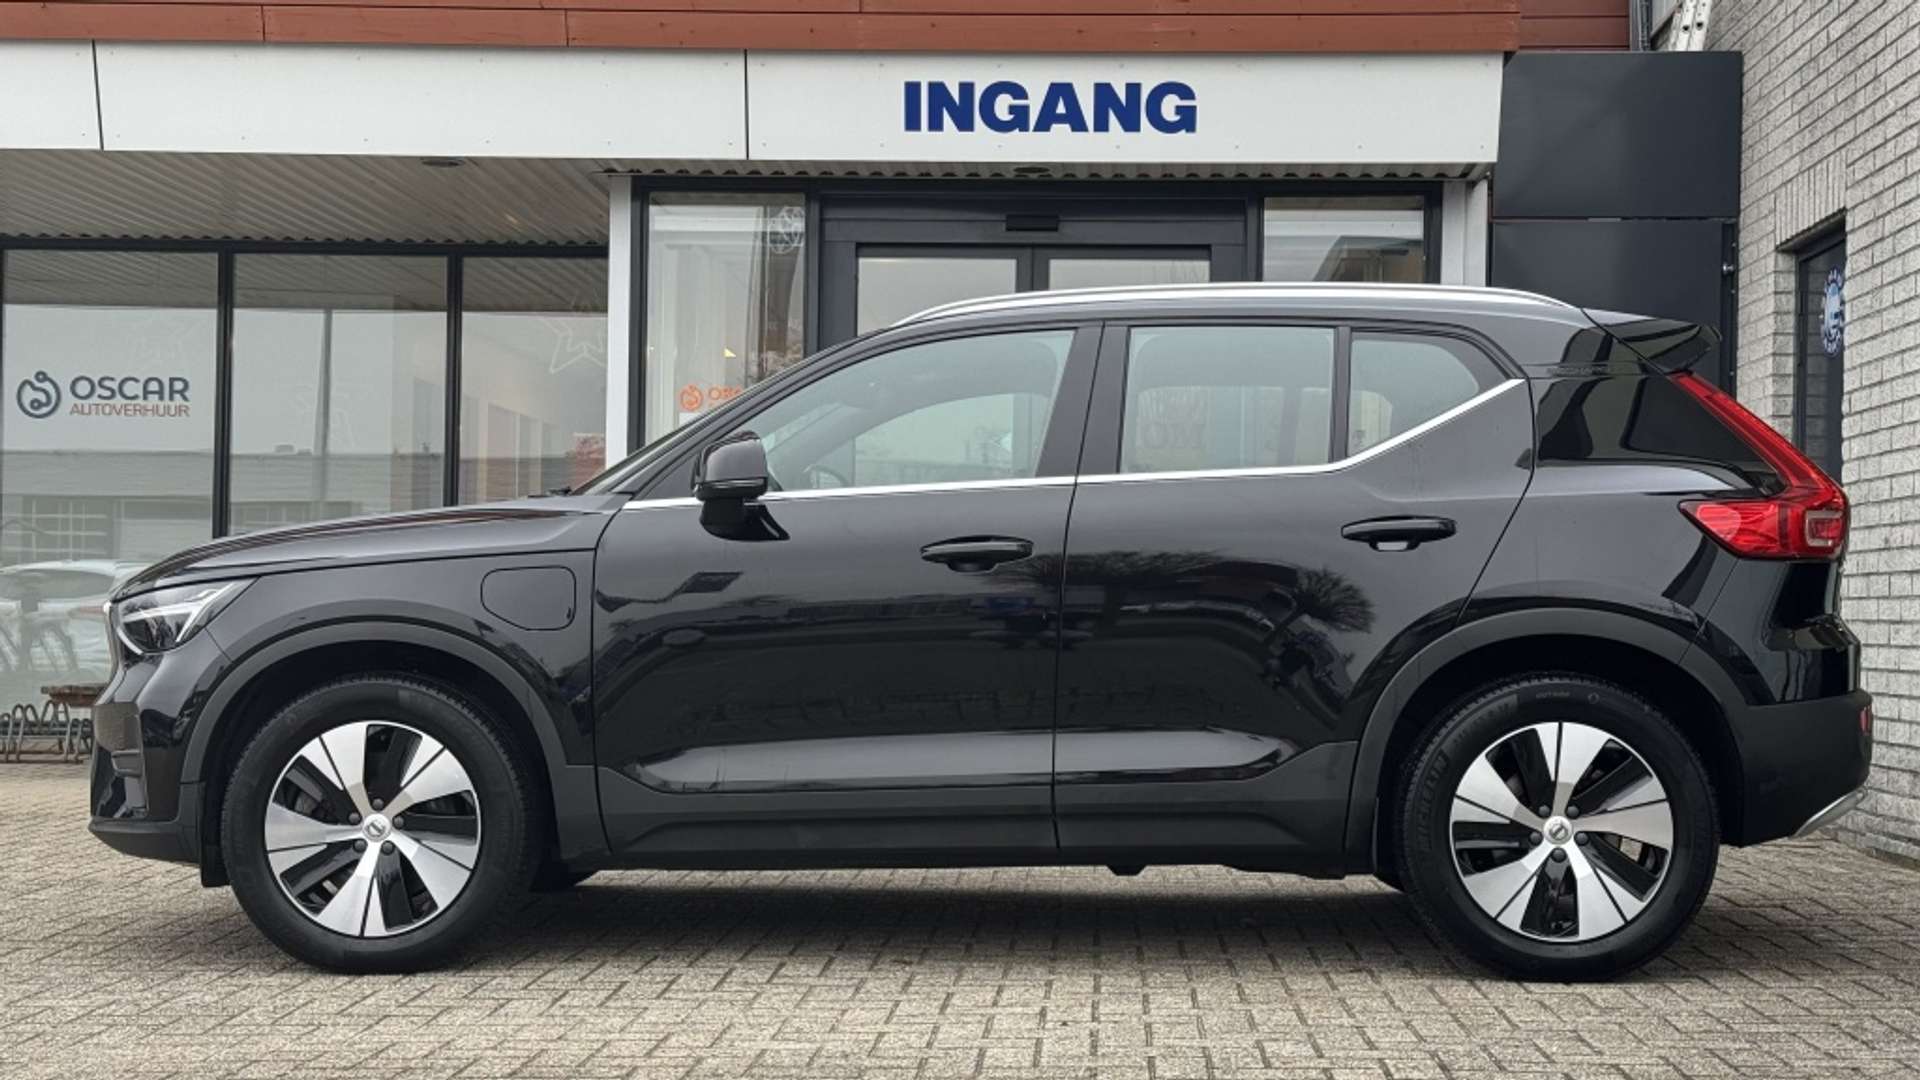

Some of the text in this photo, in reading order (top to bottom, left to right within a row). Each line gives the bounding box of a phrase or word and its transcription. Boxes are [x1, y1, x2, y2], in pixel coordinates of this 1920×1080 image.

[904, 81, 1197, 133] INGANG
[70, 376, 190, 401] OSCAR
[70, 403, 190, 417] AUTOVERHUUR
